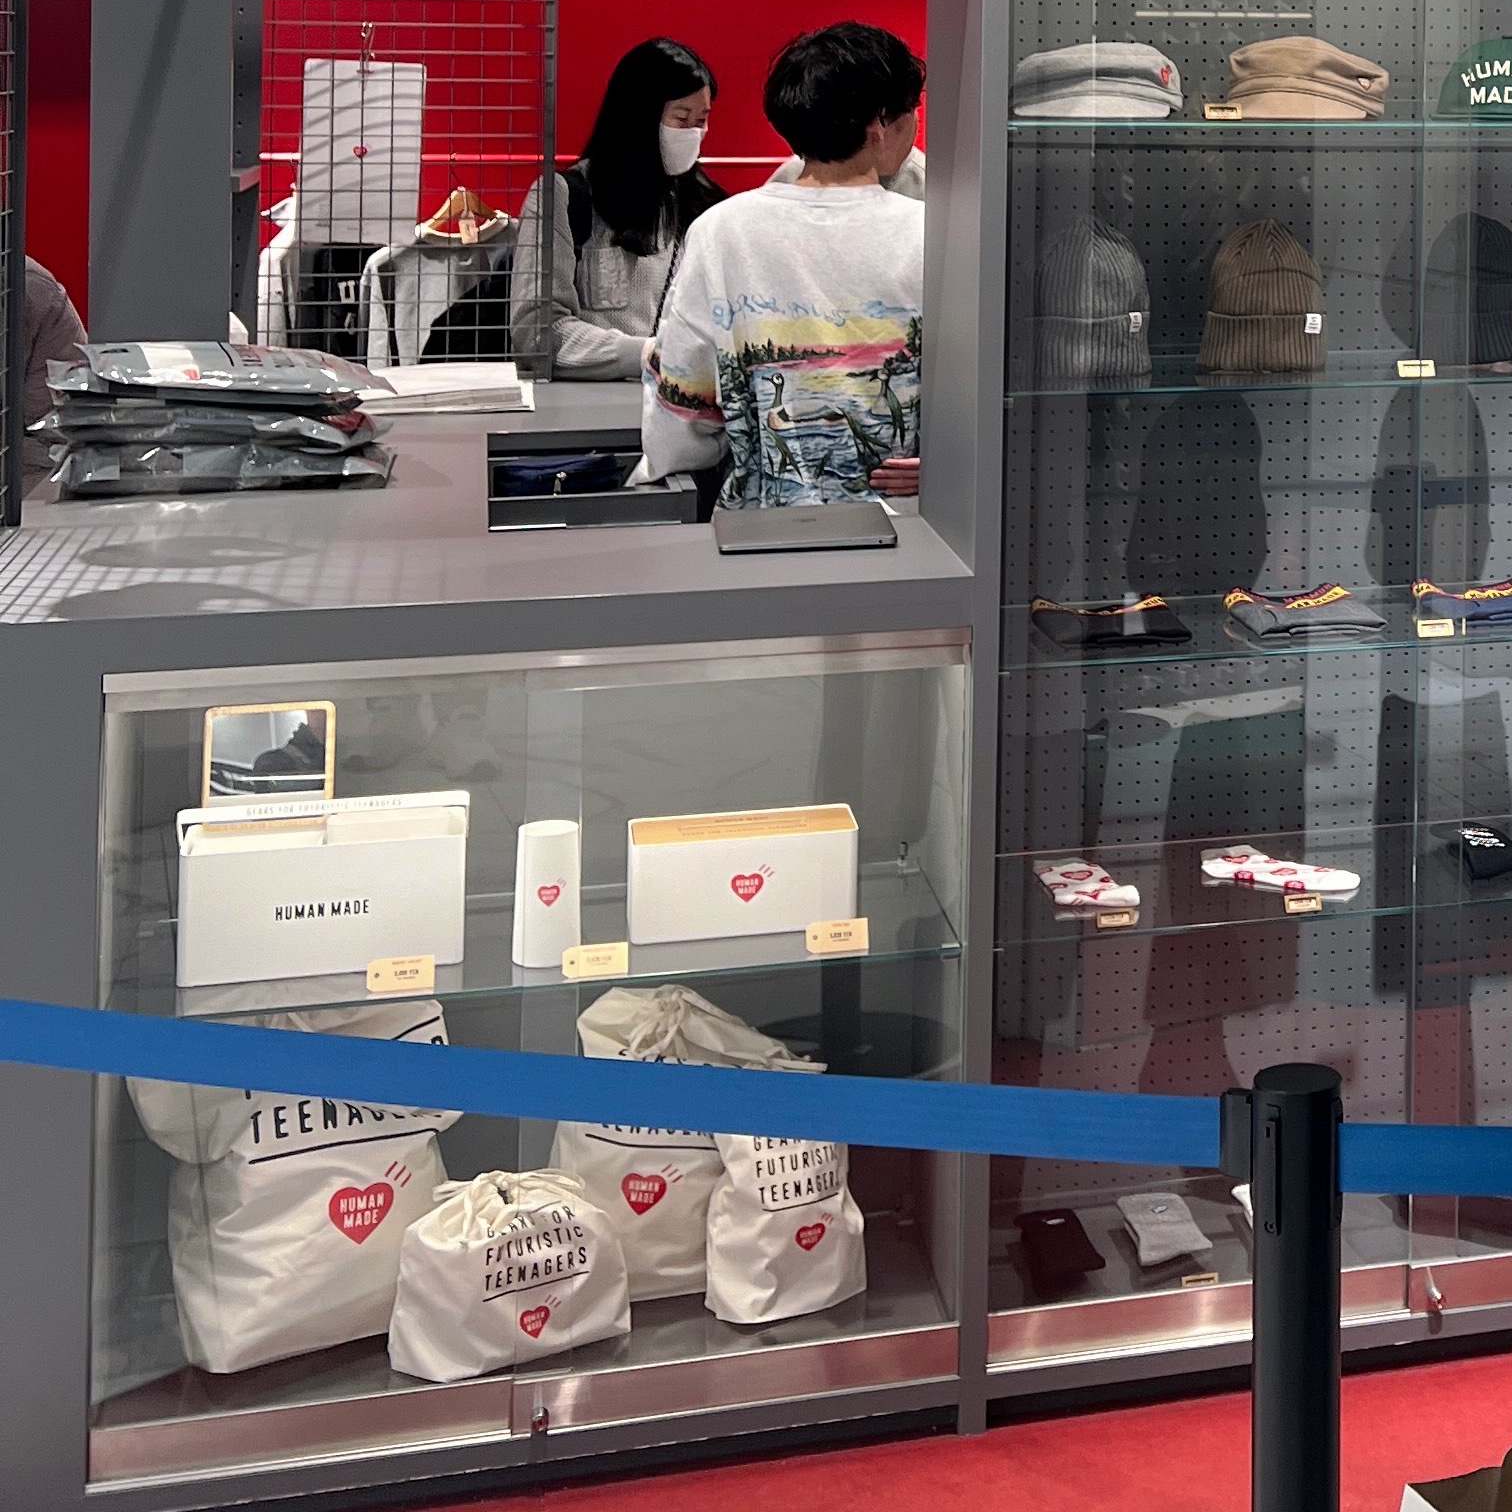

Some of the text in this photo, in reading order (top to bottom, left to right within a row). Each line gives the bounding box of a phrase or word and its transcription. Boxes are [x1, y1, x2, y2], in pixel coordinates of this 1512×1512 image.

[274, 899, 370, 921] HUMAN MADE
[339, 1192, 384, 1213] HUMAN
[343, 1211, 378, 1229] MADE
[485, 1246, 587, 1291] TEENAGERS
